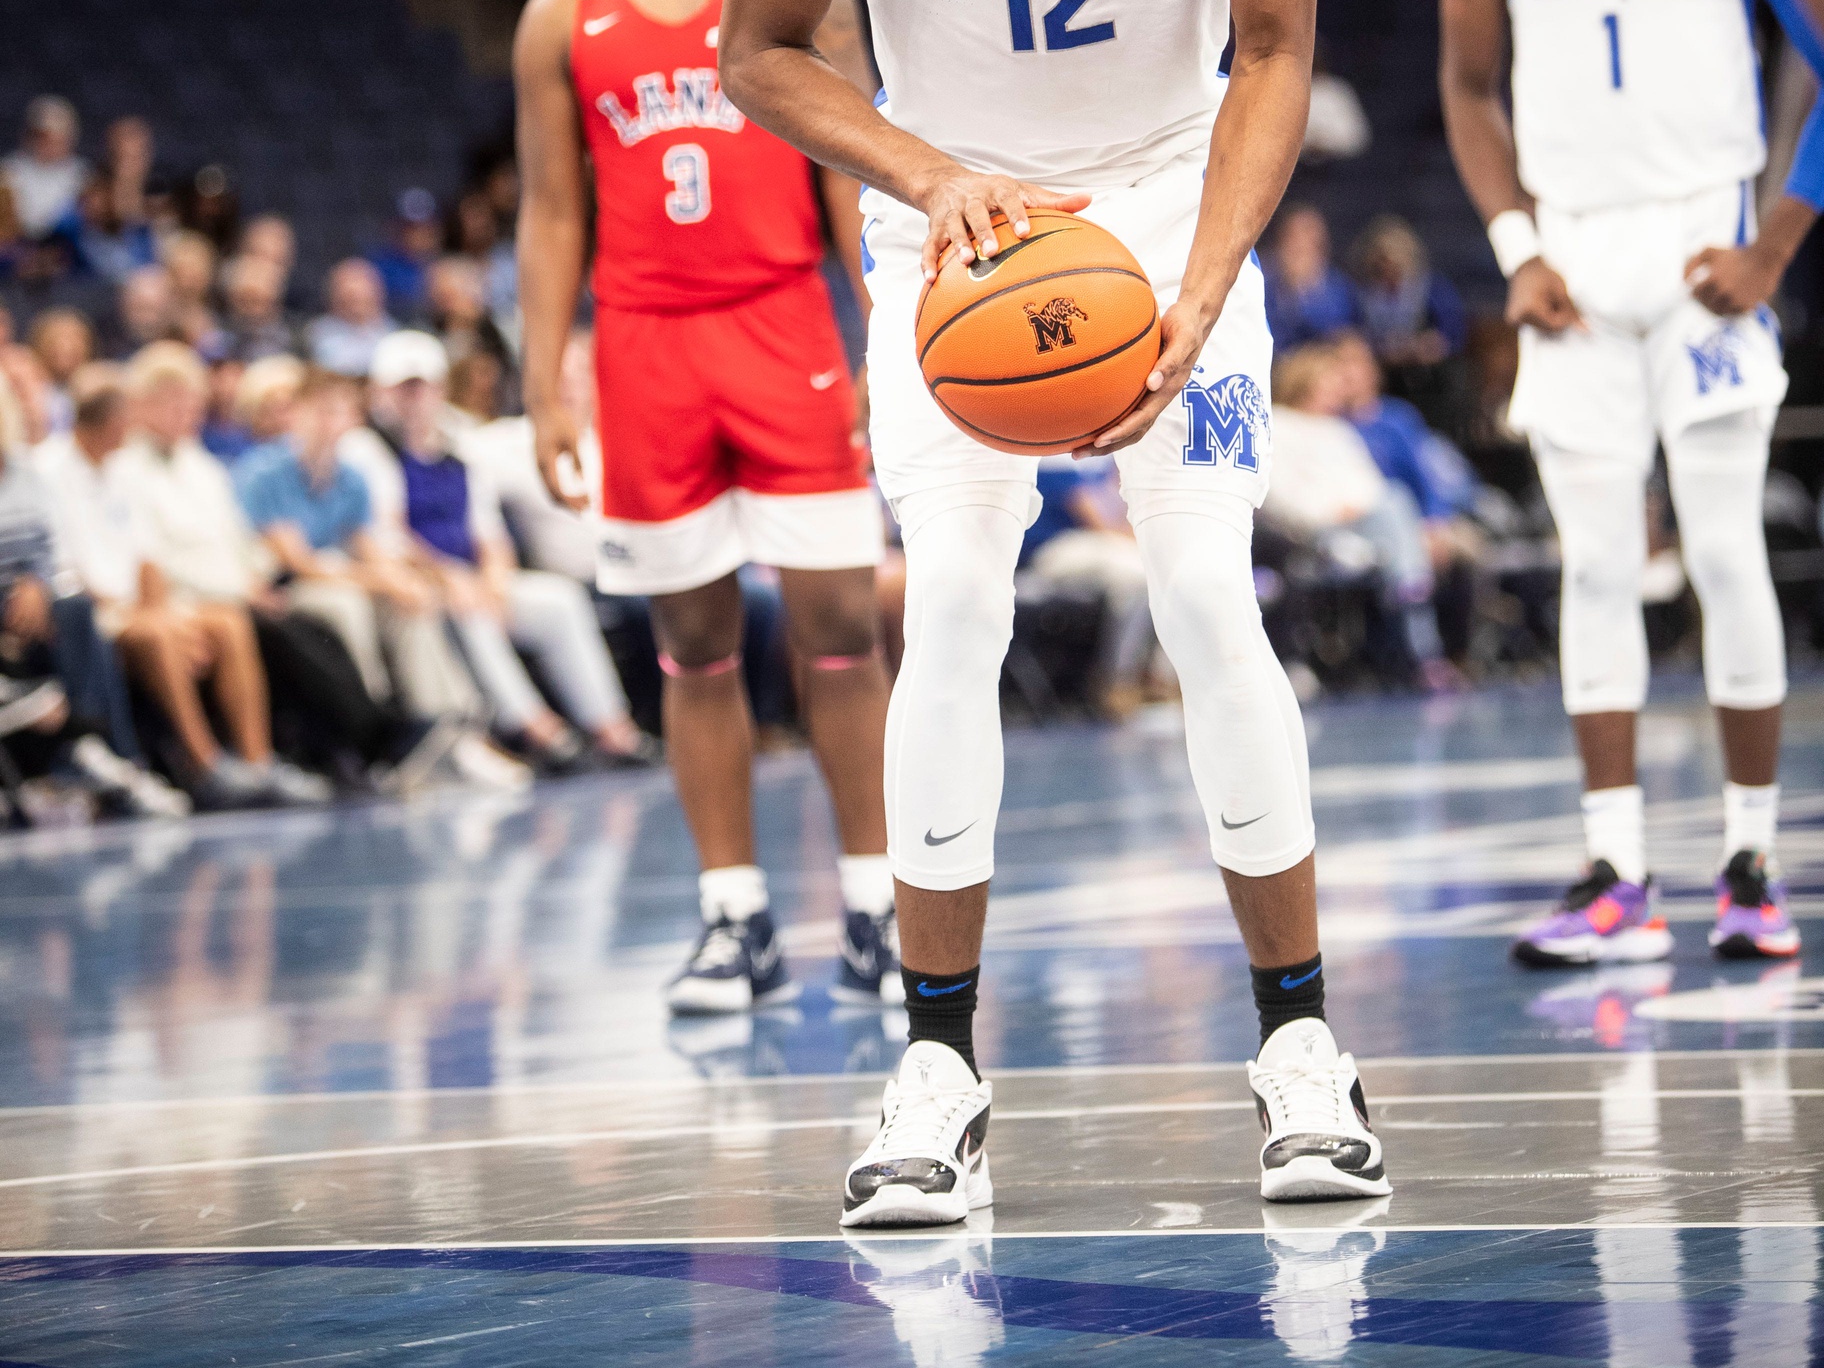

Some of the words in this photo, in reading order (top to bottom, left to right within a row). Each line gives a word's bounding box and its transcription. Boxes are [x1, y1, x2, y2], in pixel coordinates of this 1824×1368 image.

[1602, 14, 1623, 89] 1
[662, 143, 711, 224] 3
[1027, 314, 1077, 355] M
[1182, 386, 1260, 474] M
